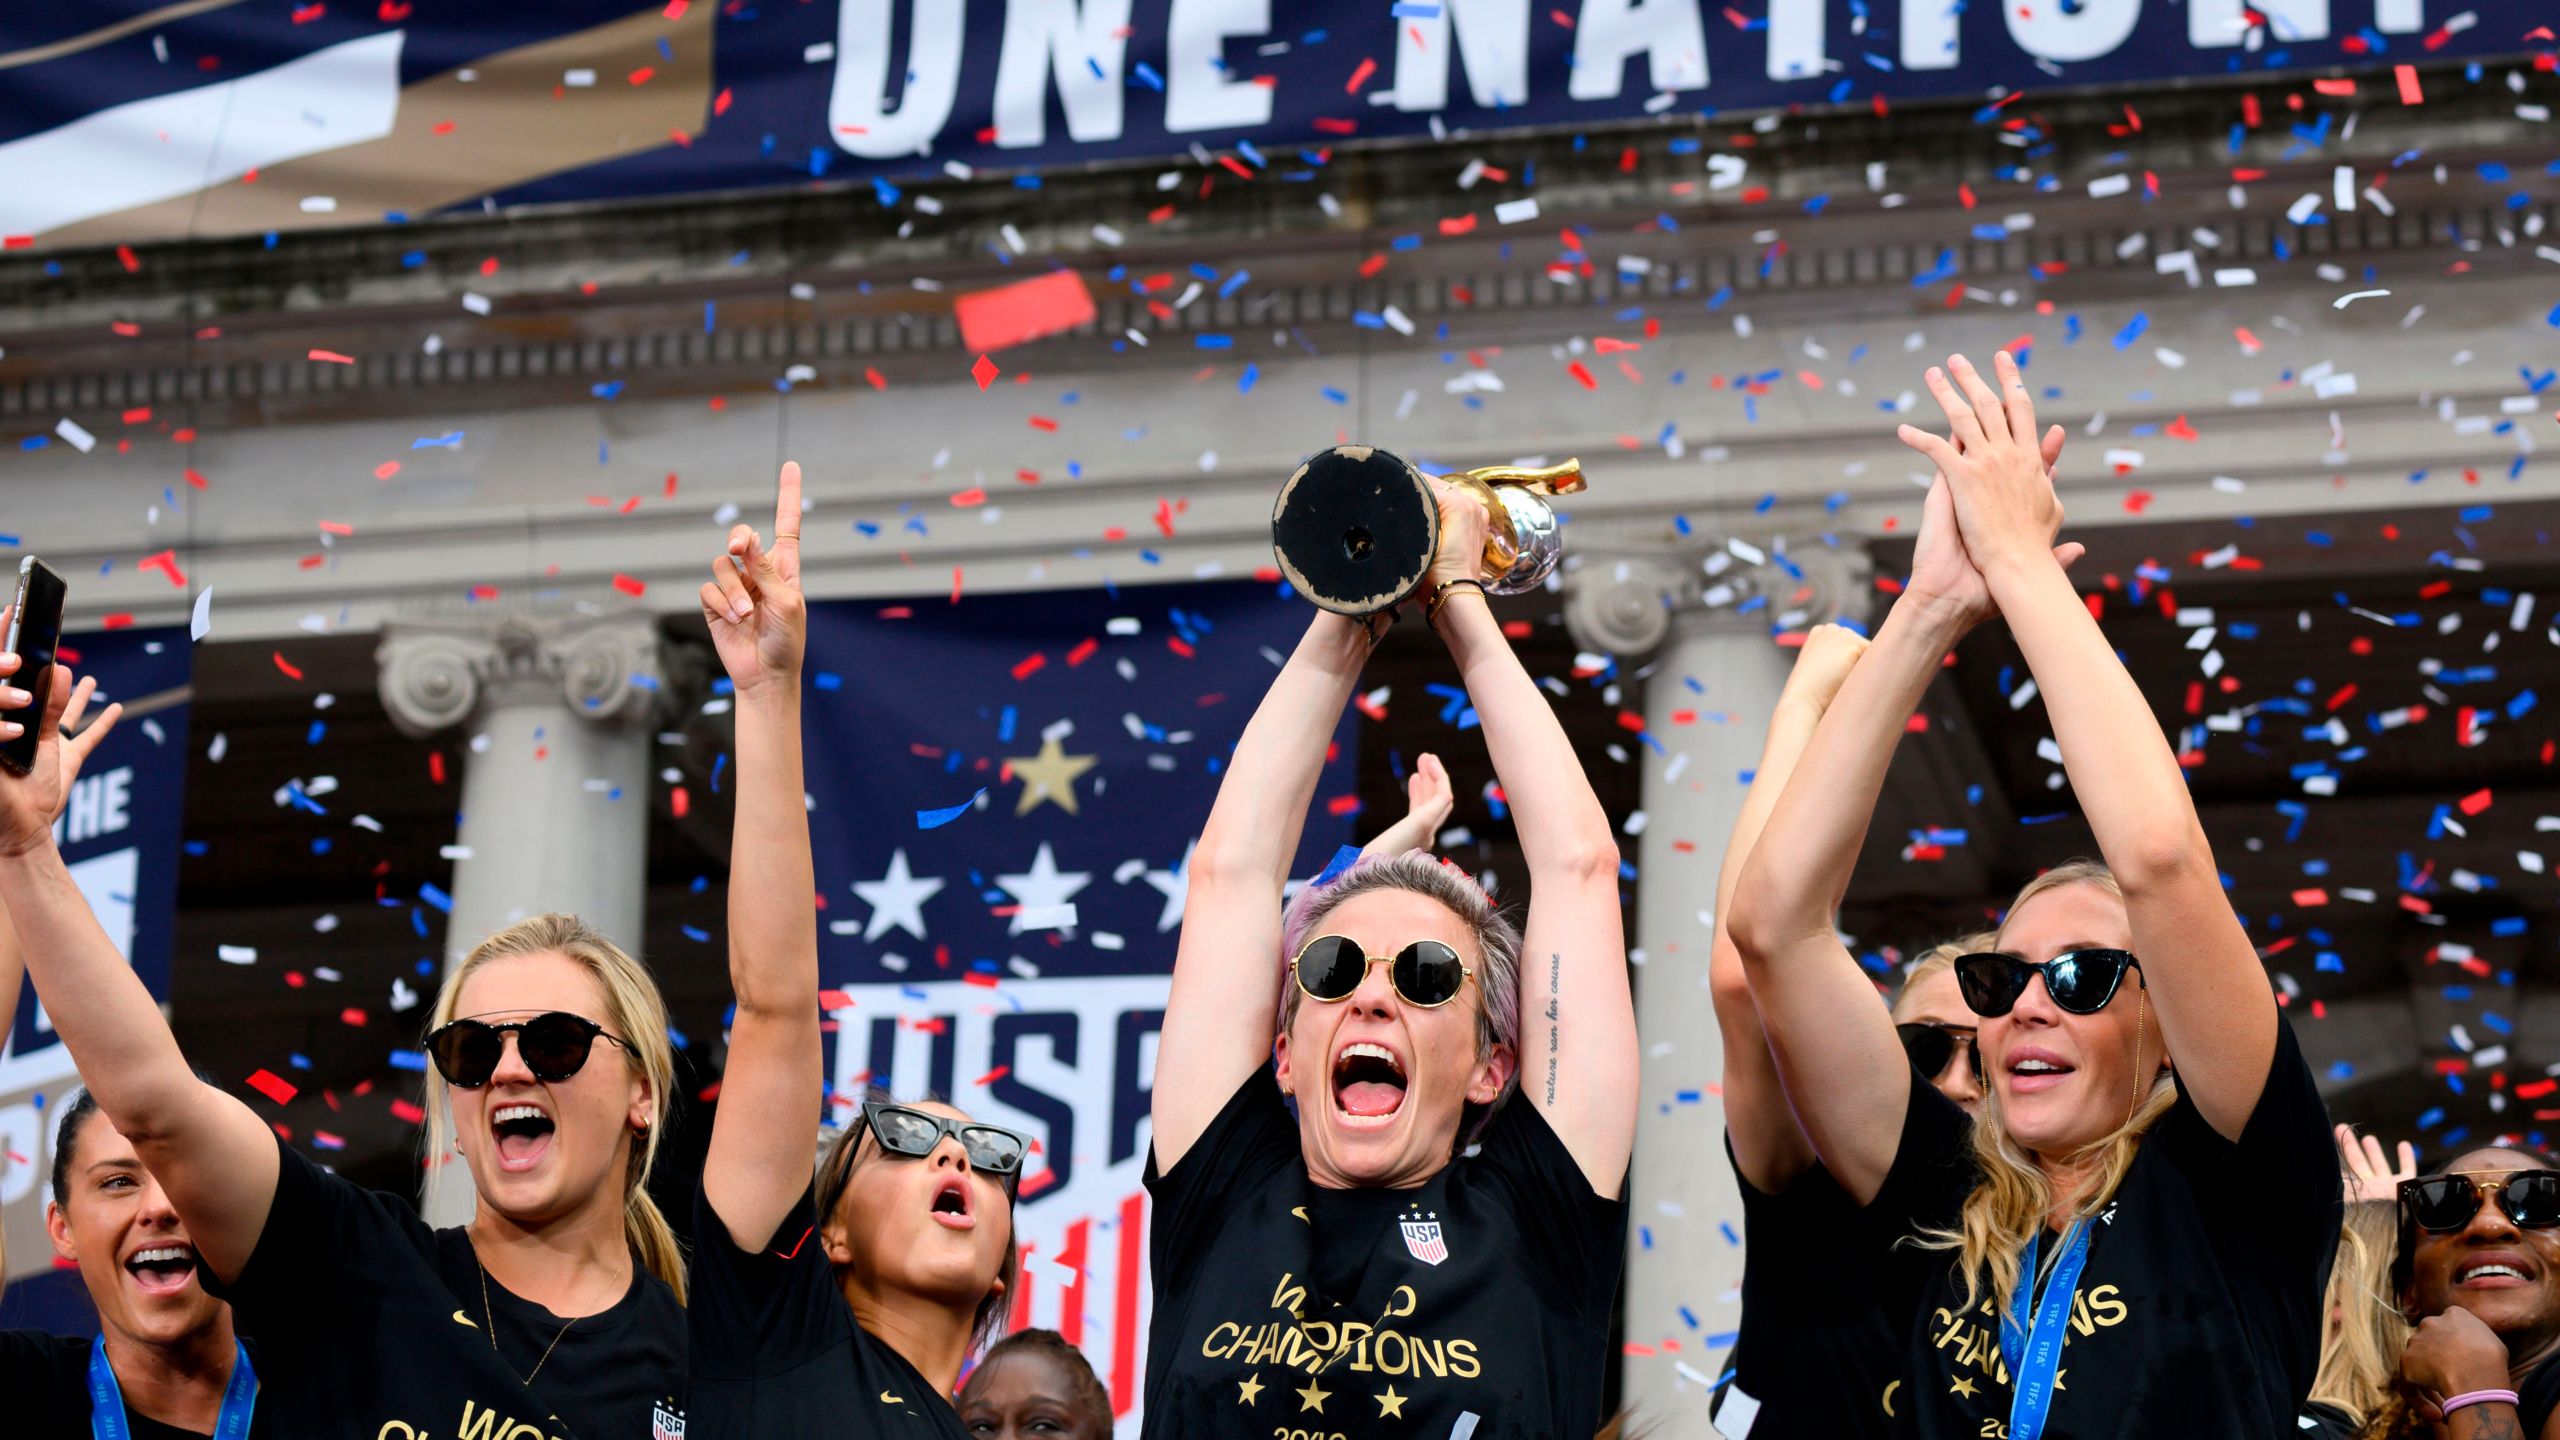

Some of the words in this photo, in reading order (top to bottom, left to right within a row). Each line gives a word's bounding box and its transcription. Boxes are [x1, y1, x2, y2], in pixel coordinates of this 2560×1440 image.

[829, 0, 1274, 159] ONE
[52, 766, 134, 846] HE
[1551, 953, 1560, 994] course
[1545, 997, 1559, 1021] her
[1546, 1057, 1558, 1106] nature
[1404, 1225, 1440, 1243] USA
[2046, 1303, 2061, 1327] FIFA
[1928, 1284, 2128, 1385] CHAMNS
[2036, 1341, 2050, 1367] FIFA
[2026, 1381, 2041, 1409] FIFA
[104, 1416, 117, 1439] FIFA
[228, 1413, 240, 1434] FIFA
[656, 1410, 683, 1433] USA
[2018, 1423, 2031, 1440] FIF
